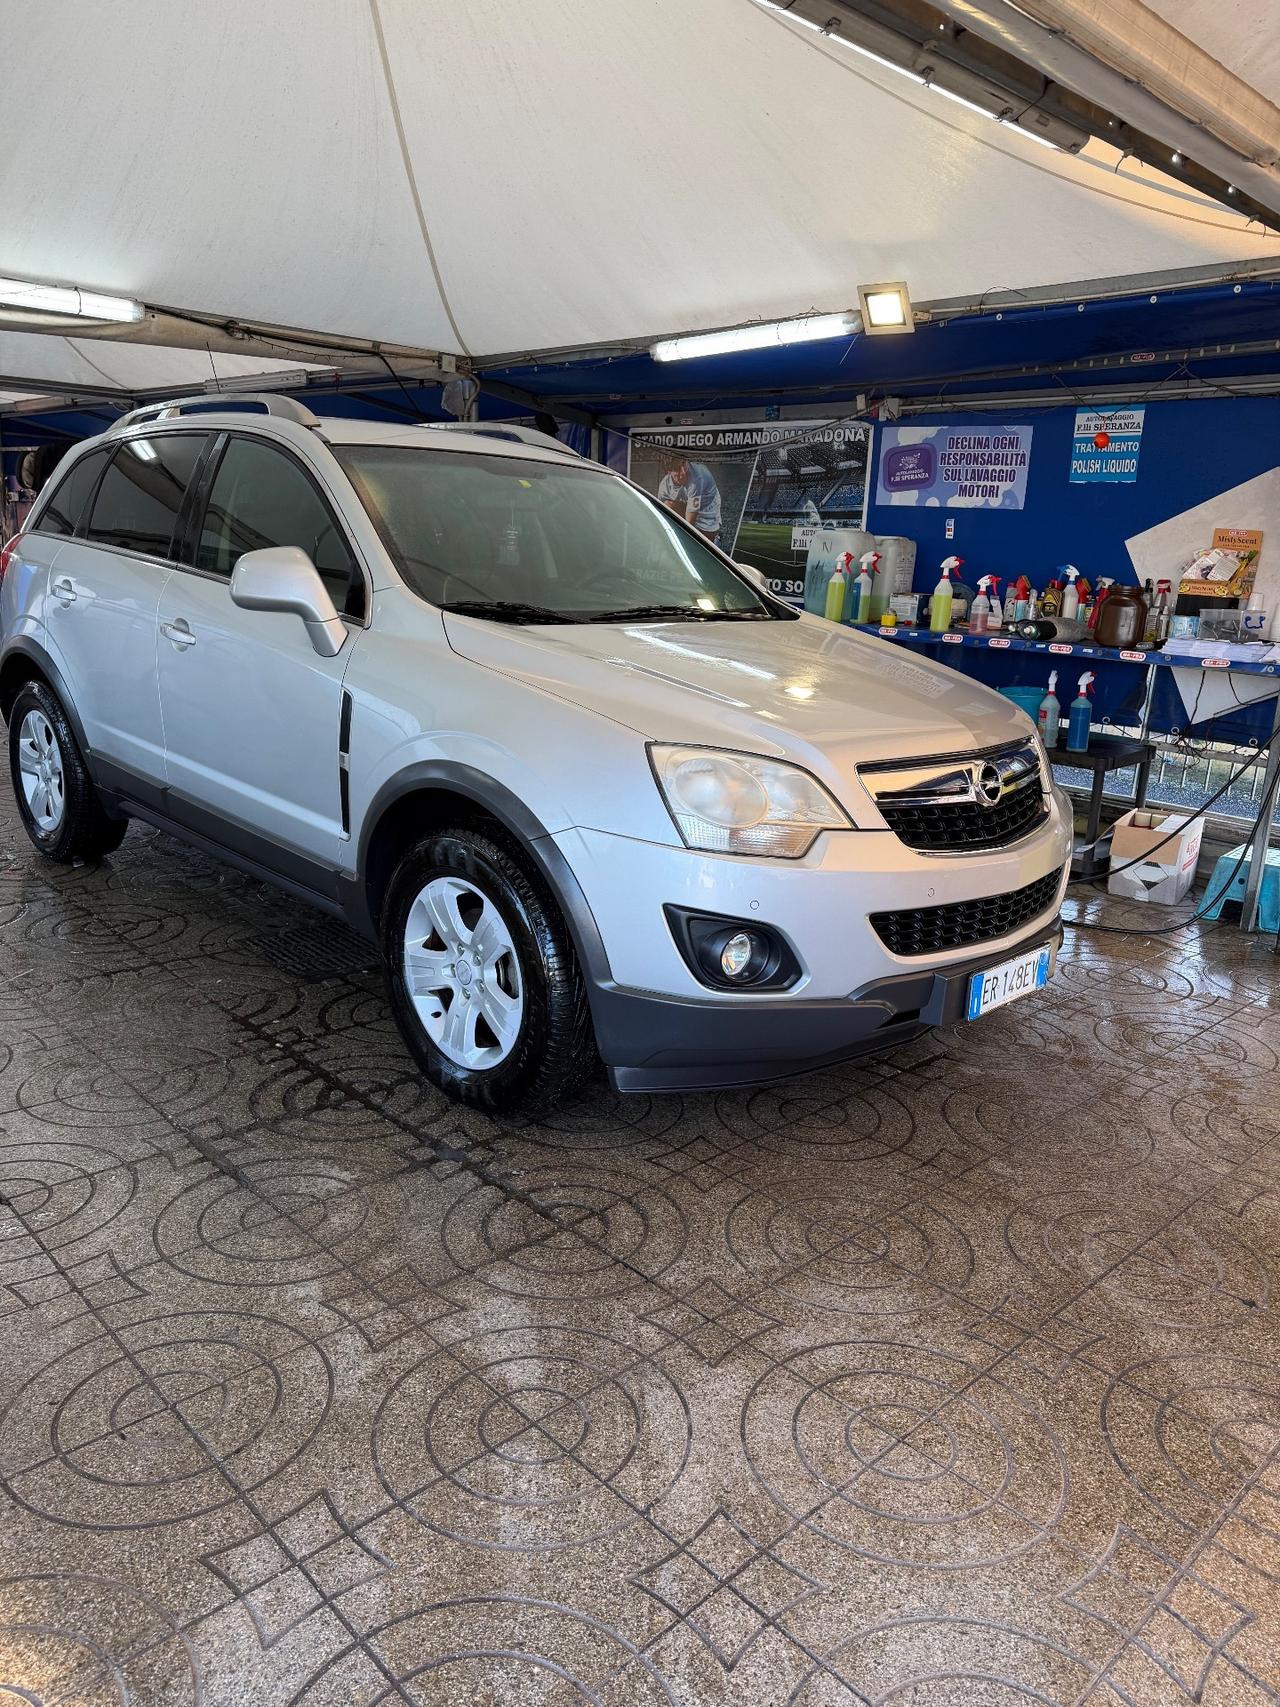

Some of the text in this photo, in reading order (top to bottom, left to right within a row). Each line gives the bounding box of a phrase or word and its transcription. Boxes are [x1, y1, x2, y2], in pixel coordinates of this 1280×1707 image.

[1094, 421, 1142, 431] SPERANZA
[677, 433, 714, 447] DIEGO
[716, 430, 780, 446] ARMANDO
[947, 436, 1020, 450] DECLINA OGNI
[939, 450, 1027, 467] RESPONSABILITÀ
[1071, 458, 1137, 474] POLISH LIQUIDO
[943, 468, 1017, 483] SUL LAVAGGIO
[957, 484, 1000, 498] MOTORI
[982, 977, 999, 1005] ER
